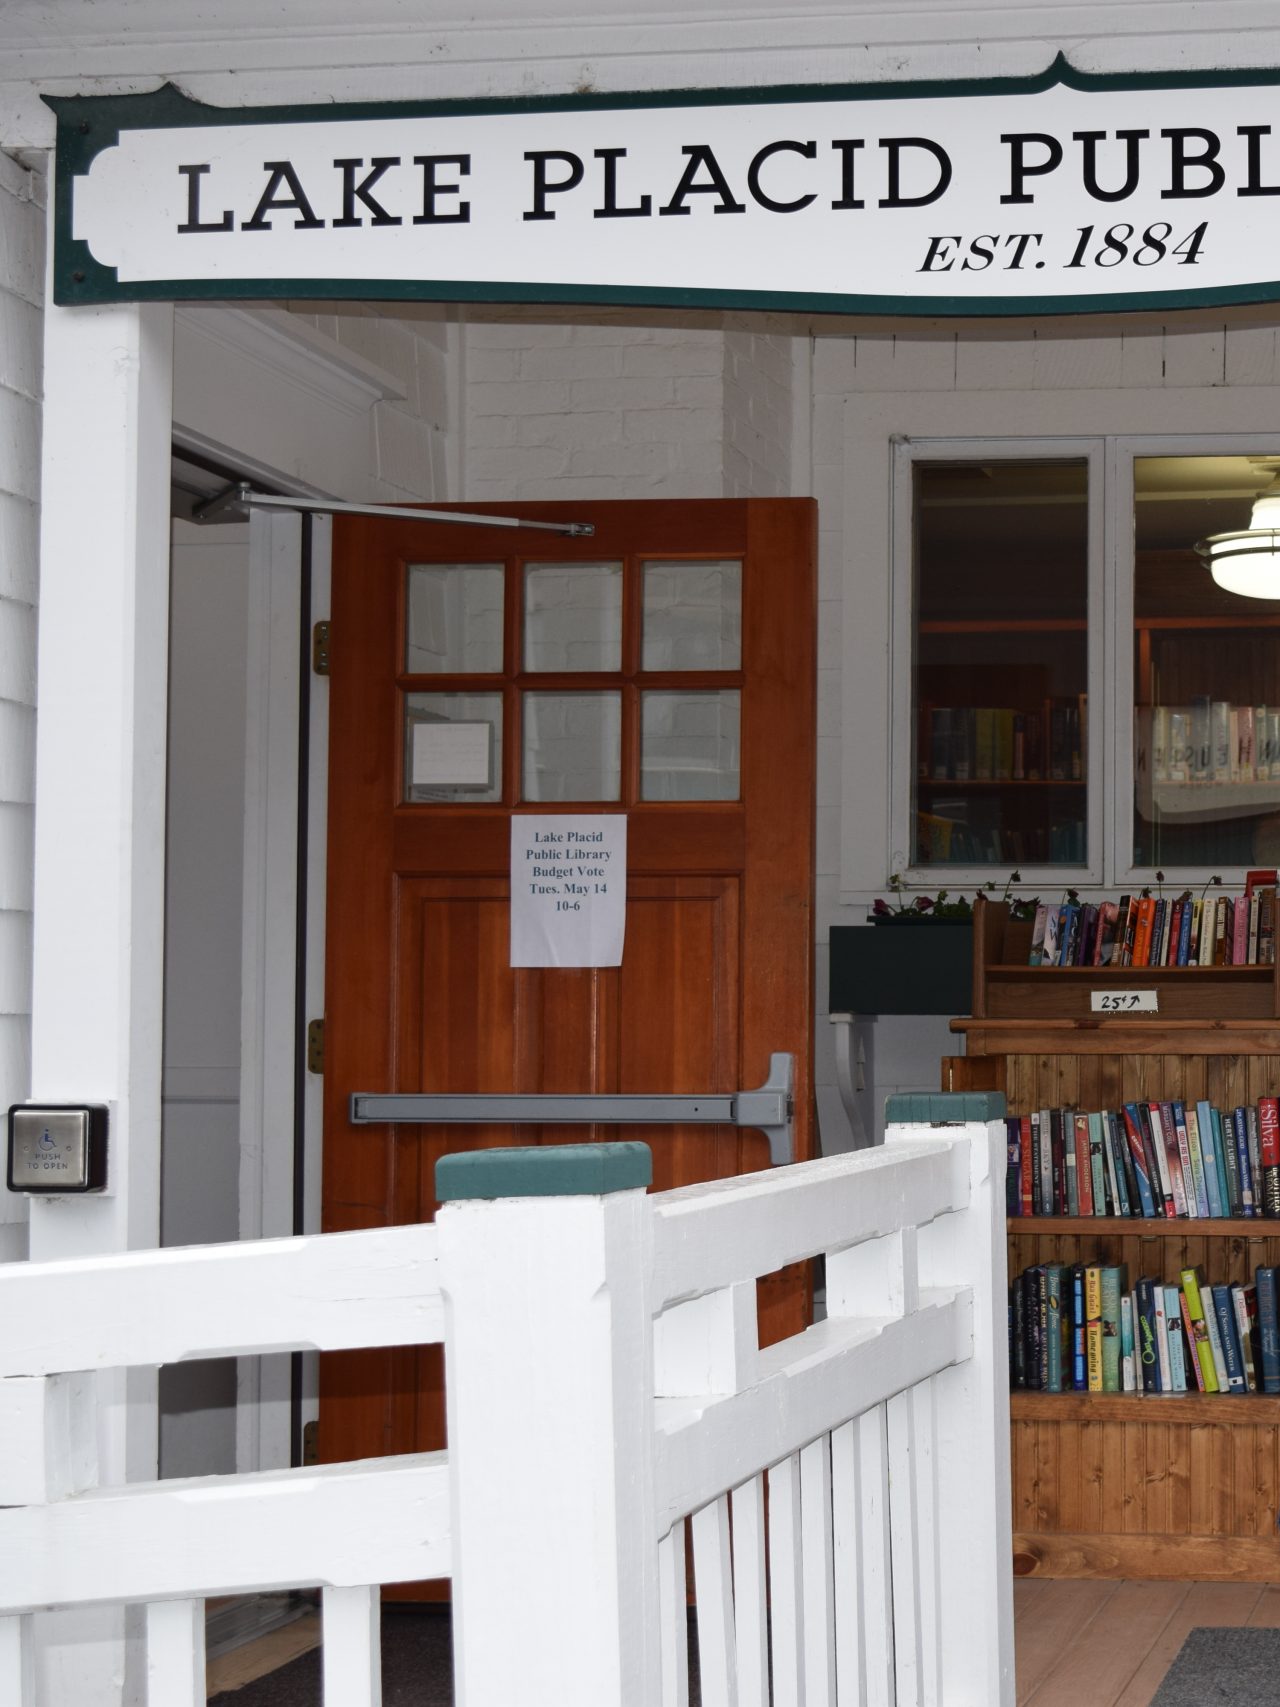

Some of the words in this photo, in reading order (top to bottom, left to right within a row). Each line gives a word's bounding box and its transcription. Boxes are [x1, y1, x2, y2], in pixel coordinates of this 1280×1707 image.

[178, 154, 471, 234] LAKE
[523, 137, 953, 222] PLACID
[918, 233, 1046, 272] EST.
[1063, 221, 1210, 268] 1884
[535, 832, 564, 843] Lake
[567, 832, 603, 843] Placid
[526, 849, 562, 860] Public
[566, 849, 612, 862] Library
[533, 866, 573, 879] Budget
[578, 866, 604, 877] Vote
[530, 883, 560, 894] Tues.
[564, 883, 590, 896] May
[594, 883, 607, 894] 14
[556, 901, 580, 911] 10-6
[1260, 1109, 1279, 1147] Silva
[35, 1153, 61, 1161] PUSH
[27, 1162, 40, 1170] TO
[43, 1162, 69, 1170] OPEN
[1022, 1149, 1031, 1181] SUGAR
